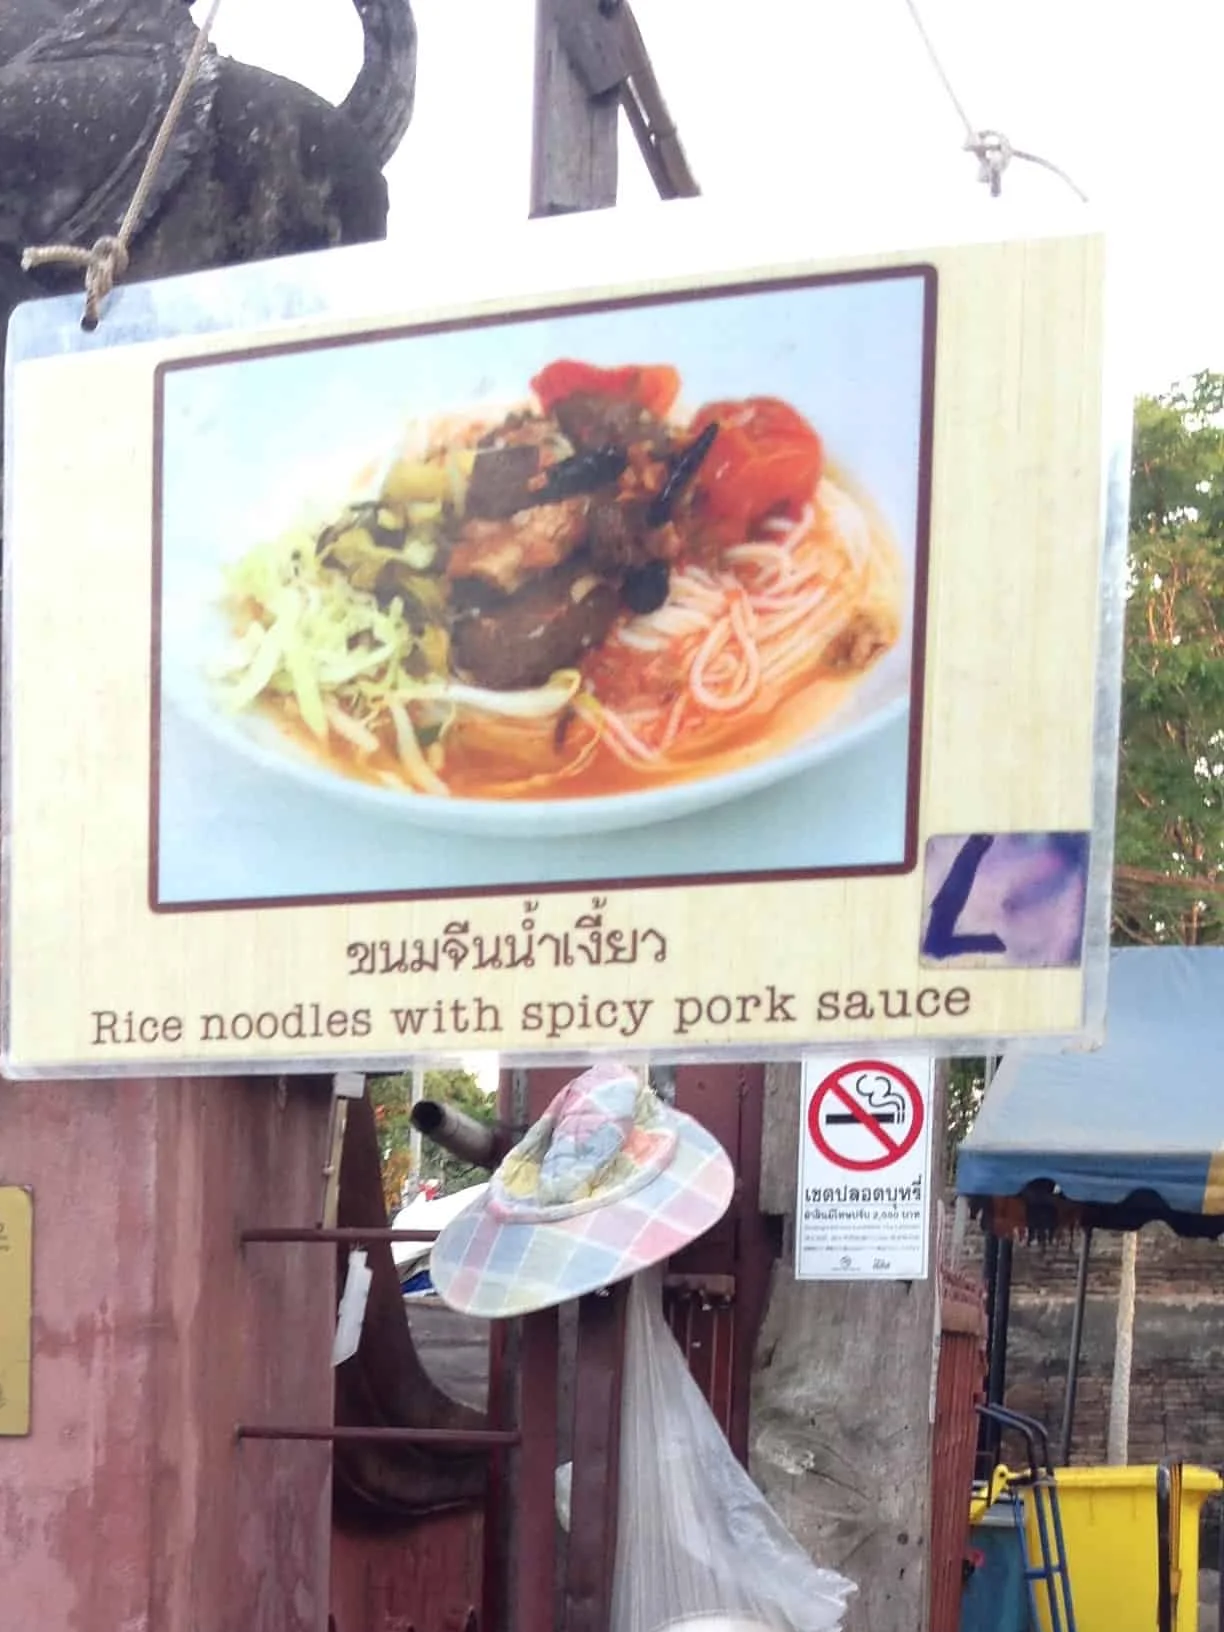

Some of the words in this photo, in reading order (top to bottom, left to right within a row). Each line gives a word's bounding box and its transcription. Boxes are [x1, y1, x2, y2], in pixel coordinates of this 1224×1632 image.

[347, 900, 667, 977] ขนมจีนน้ำเงี้ยว
[91, 1010, 183, 1046] Rice
[199, 1003, 373, 1041] noodles
[389, 998, 503, 1036] with
[521, 995, 655, 1039] spicy
[673, 986, 792, 1028] pork
[816, 986, 972, 1022] sauce
[804, 1174, 922, 1210] เขตปลอดบุหรี่
